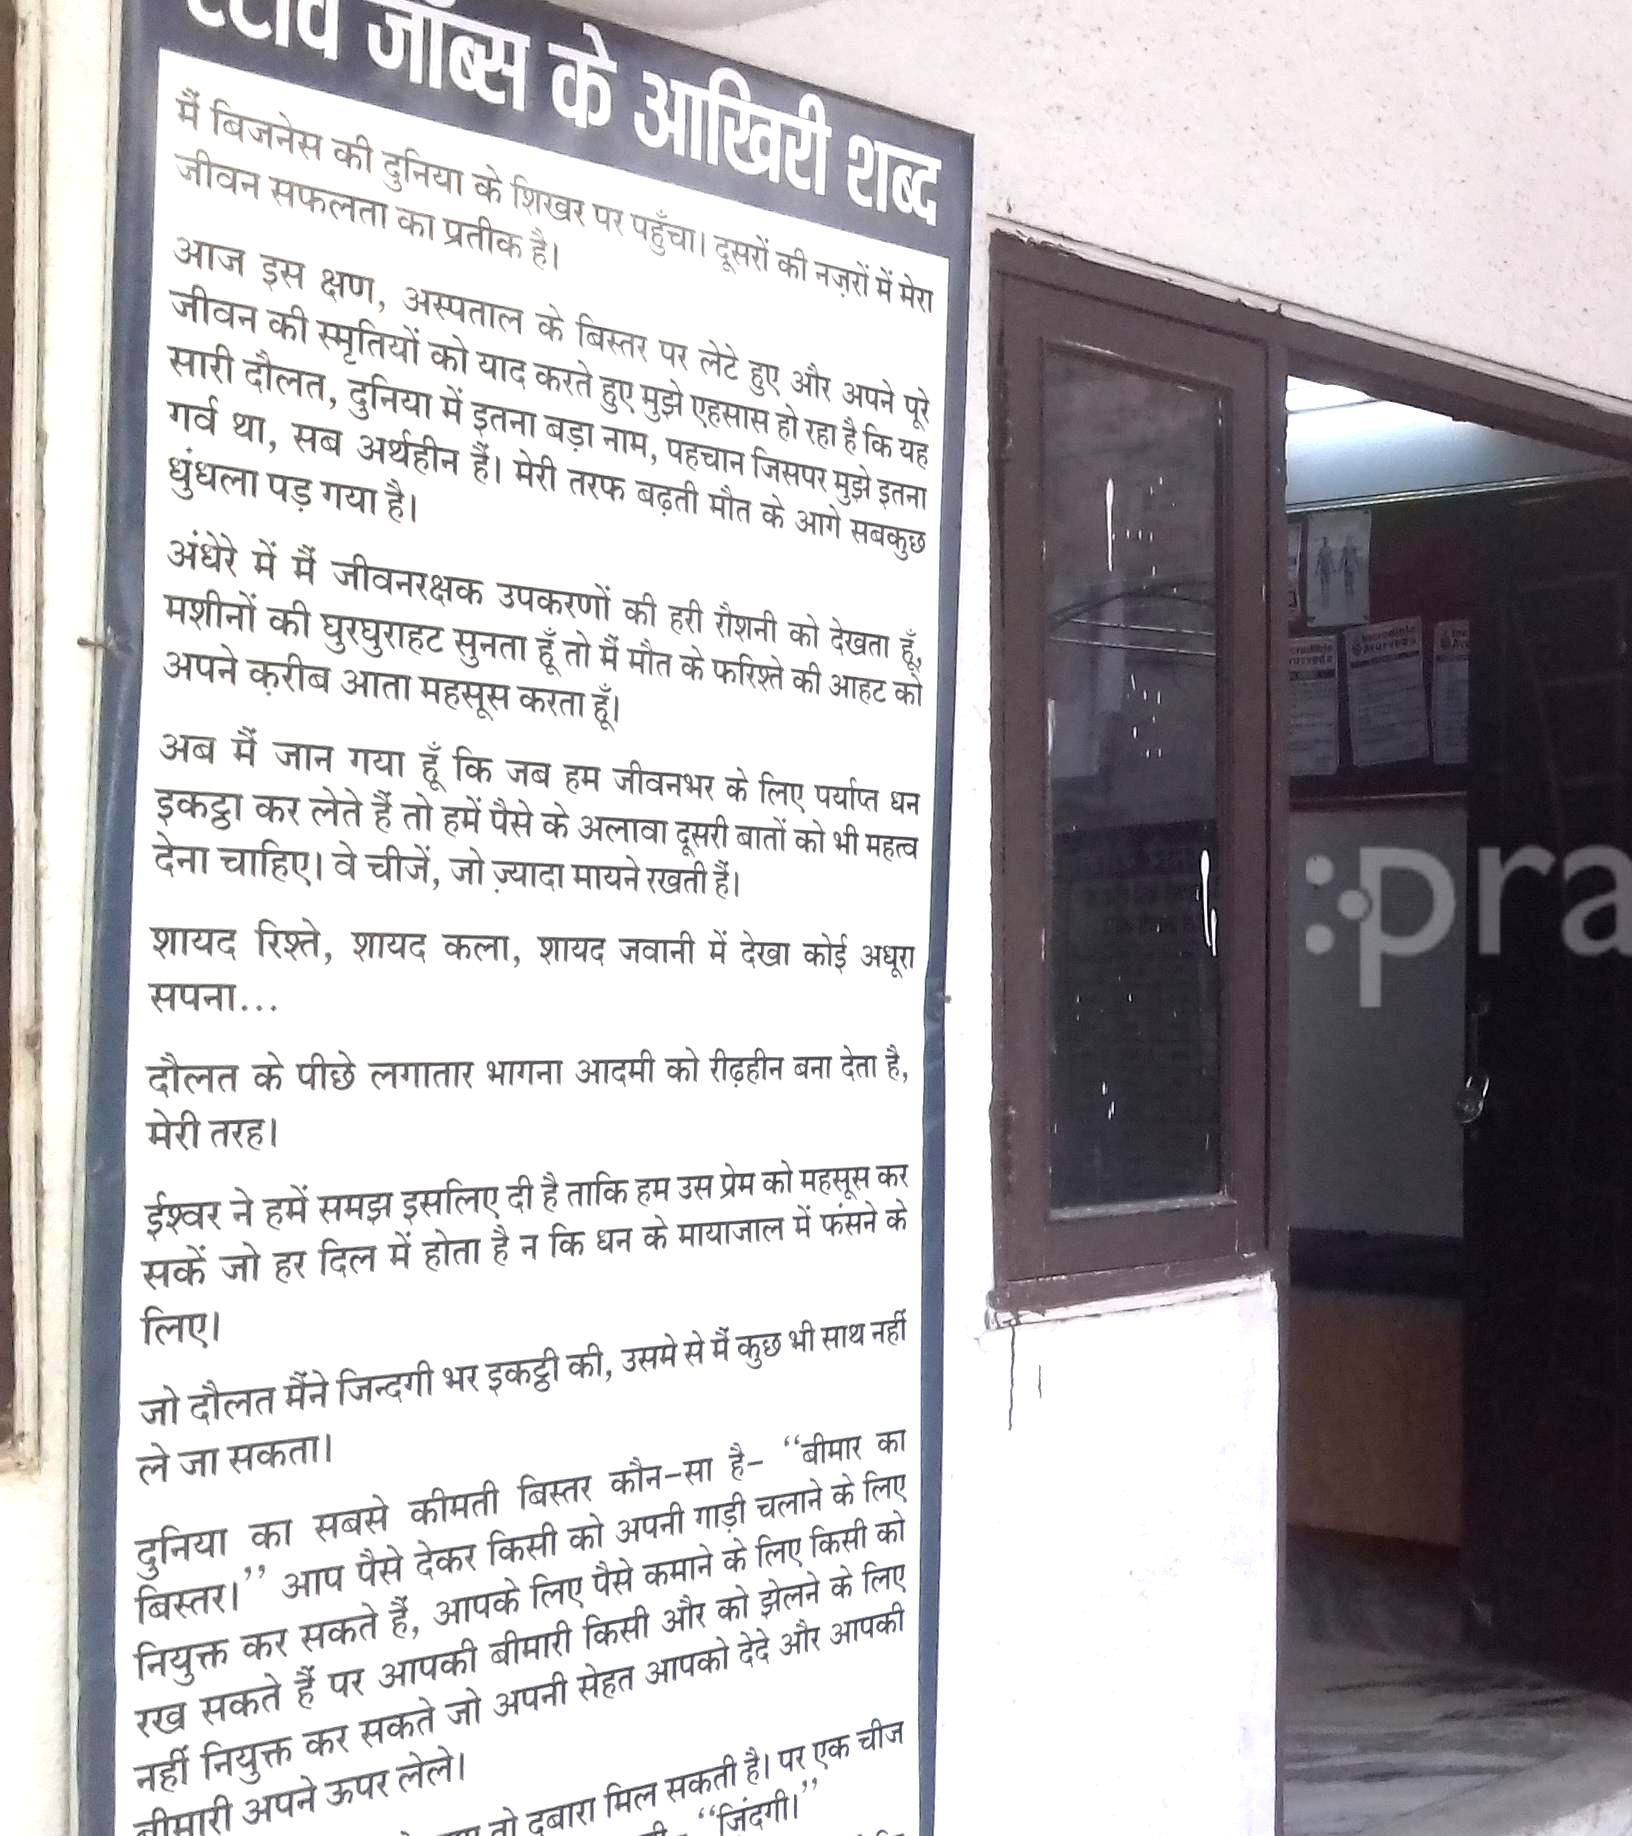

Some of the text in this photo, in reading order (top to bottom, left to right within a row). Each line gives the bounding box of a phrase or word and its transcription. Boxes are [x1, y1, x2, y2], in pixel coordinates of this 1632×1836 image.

[547, 22, 617, 129] के
[634, 67, 832, 196] आखिरी
[847, 135, 942, 226] शब्द
[149, 917, 915, 978] शायद रिश्ते, शायद कला, शायद जवानी में देखा कोई अधूरा
[148, 983, 277, 1012] सपना...
